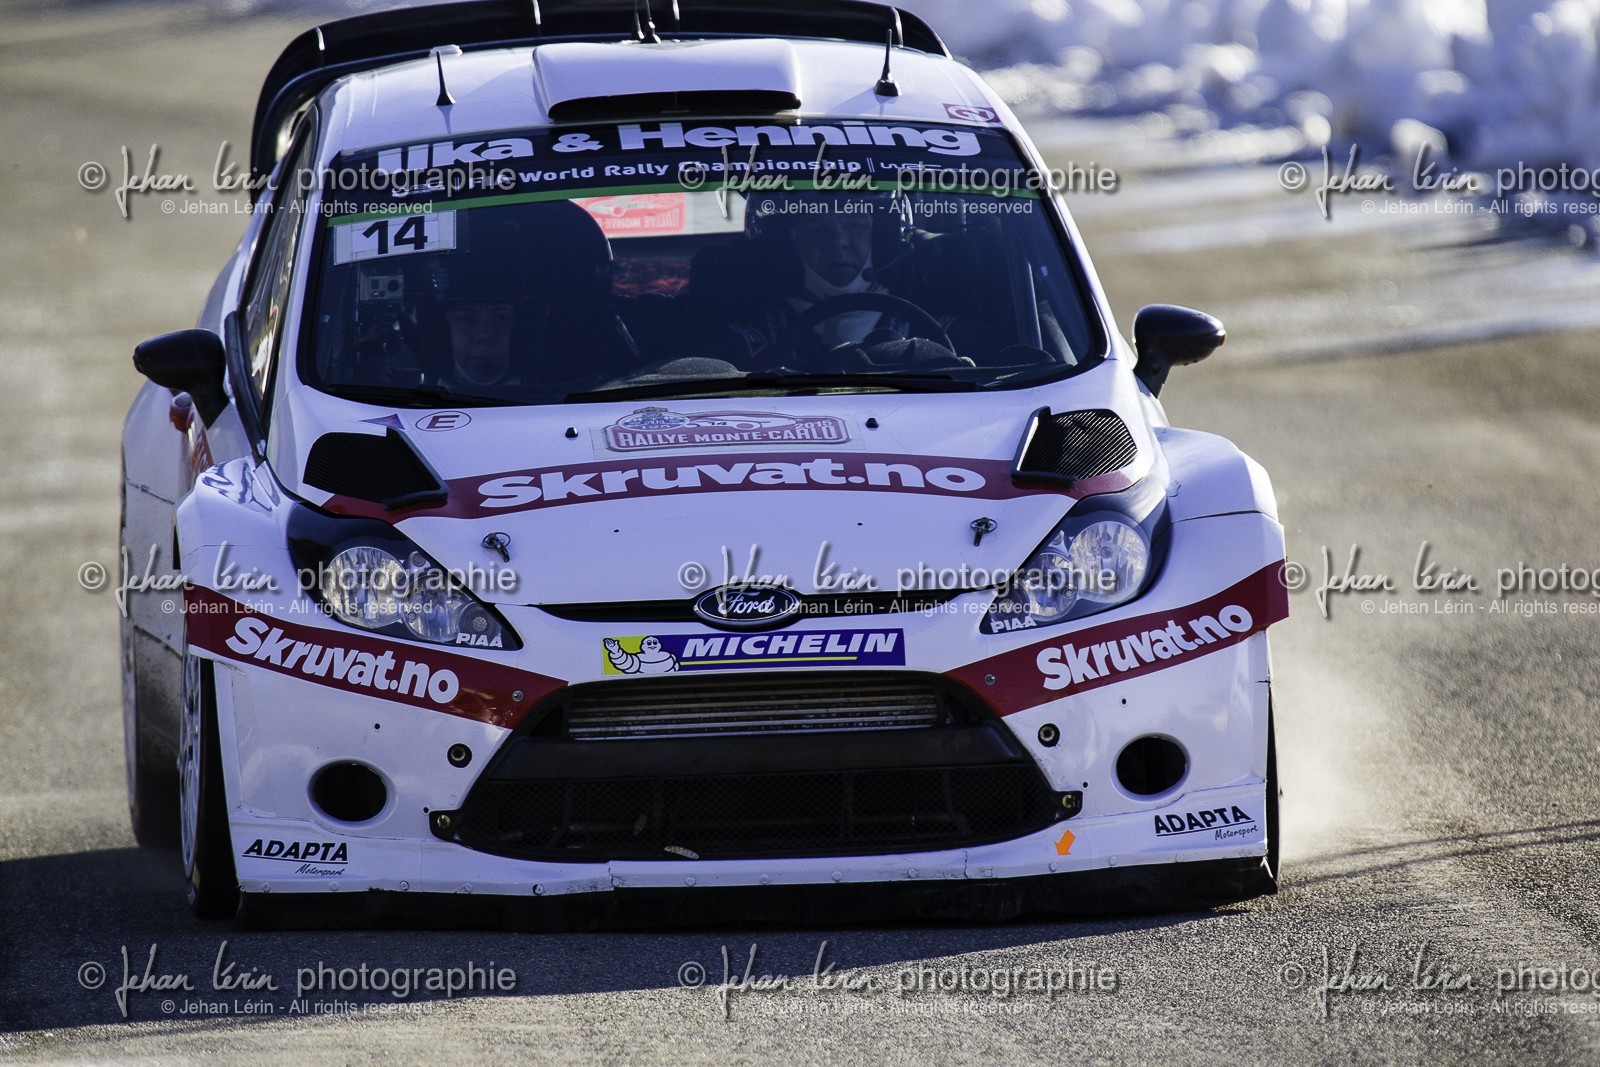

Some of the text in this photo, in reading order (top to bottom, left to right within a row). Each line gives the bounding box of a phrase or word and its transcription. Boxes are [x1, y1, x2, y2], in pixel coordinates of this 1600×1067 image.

[552, 133, 604, 152] &
[618, 121, 982, 156] Henning
[518, 167, 594, 183] World
[604, 163, 669, 176] Rally
[678, 159, 862, 172] Championship
[362, 215, 428, 254] 14
[426, 415, 460, 429] E
[794, 420, 833, 429] 2015
[618, 426, 838, 446] RALLYE MONTE-CARLO
[478, 457, 985, 508] Skruvat.no
[718, 591, 775, 615] Ford
[991, 615, 1037, 633] PIAA
[456, 632, 503, 648] PIAA
[682, 633, 898, 658] MICHELIN
[1036, 604, 1253, 690] Skruvat.no
[226, 616, 459, 704] Skruvat.no
[1154, 806, 1251, 834] ADAPTA
[1215, 825, 1258, 840] Motorsport
[244, 839, 348, 861] ADAPTA
[295, 864, 345, 877] Motorsport
